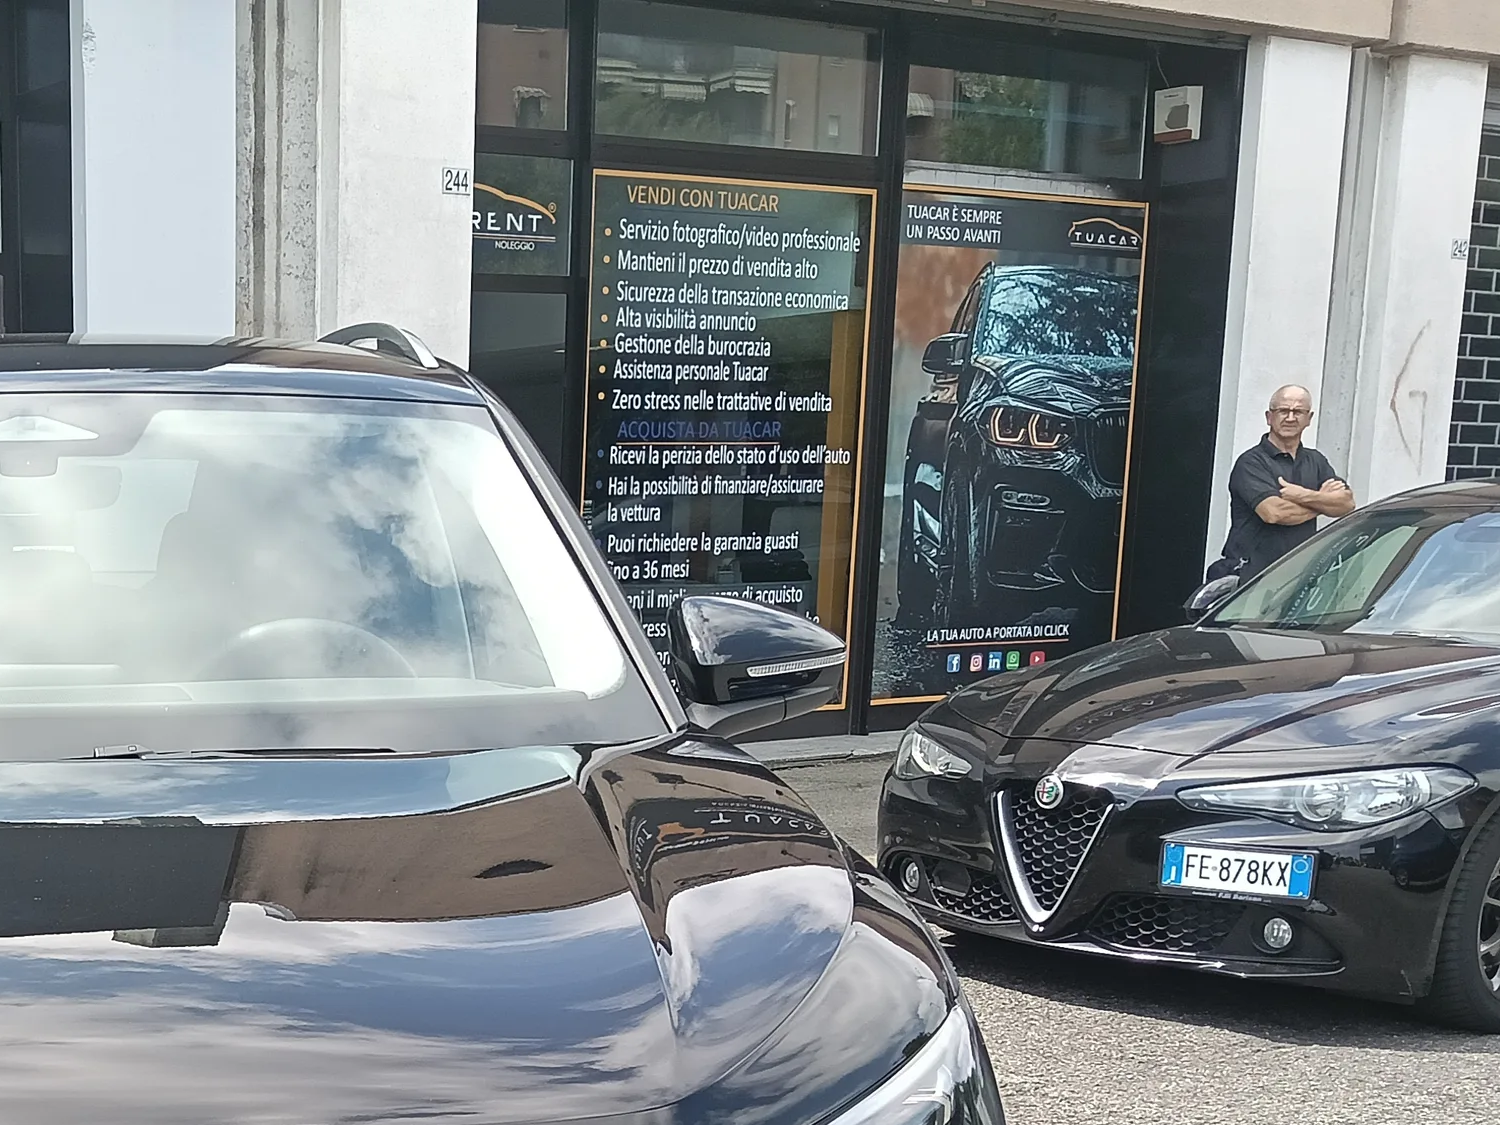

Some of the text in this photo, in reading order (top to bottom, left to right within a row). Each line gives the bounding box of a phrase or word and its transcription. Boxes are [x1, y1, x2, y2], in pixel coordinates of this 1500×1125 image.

[445, 169, 469, 193] 244
[627, 185, 779, 213] VENDI CON TUACAR
[907, 204, 1003, 225] TUACAR È SEMPRE
[494, 240, 535, 251] NOLEGGIO
[619, 217, 861, 252] Servizio fotografico/video professionale
[906, 224, 1002, 244] UN PASSO AVANTI
[1074, 231, 1139, 247] TUACAR
[1453, 240, 1468, 257] 242
[617, 249, 818, 280] Mantieni il prezzo di vendita alto
[616, 280, 849, 310] Sicurezza della transazione economica
[615, 307, 756, 332] Alta visibilità annuncio
[614, 333, 771, 357] Gestione della burocrazia
[613, 358, 769, 385] Assistenza personale Tuacar
[612, 389, 832, 412] Zero stress nelle trattative di vendita
[617, 420, 782, 440] ACQUISTA DA TUACAR
[609, 445, 646, 465] Ricevi
[649, 444, 659, 465] la
[662, 445, 702, 469] perizia
[704, 444, 734, 465] dello
[736, 447, 766, 465] stato
[608, 474, 824, 499] Hai la possibilità di finanziare/assicurare
[607, 502, 618, 522] la
[620, 504, 661, 523] vettura
[607, 531, 799, 556] Puoi richiedere la garanzia guasti
[632, 565, 640, 579] a
[642, 560, 658, 579] 36
[661, 559, 690, 578] mesi
[647, 588, 655, 608] il
[926, 624, 1070, 642] LA TUA AUTO A PORTATA DI CLICK
